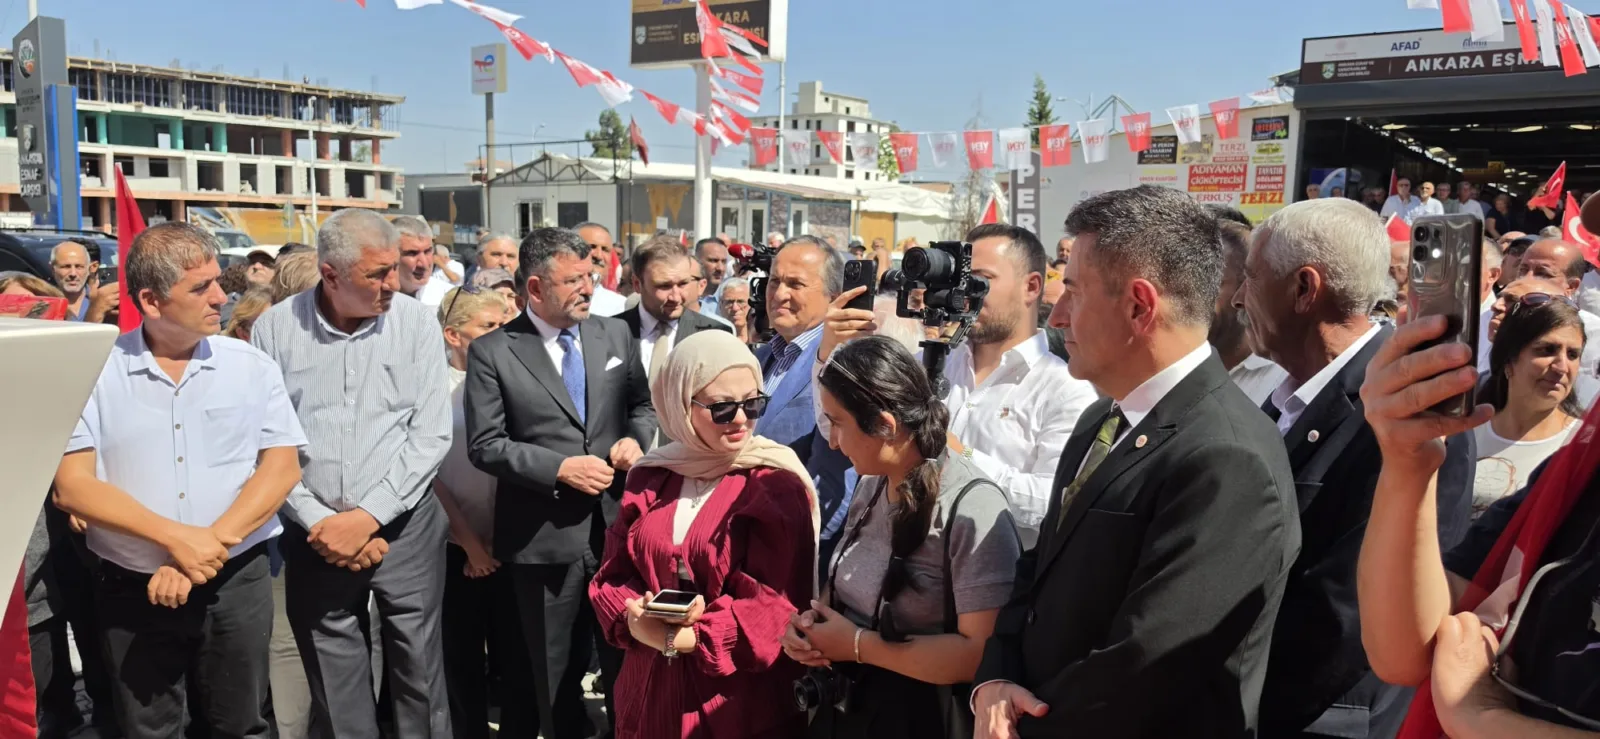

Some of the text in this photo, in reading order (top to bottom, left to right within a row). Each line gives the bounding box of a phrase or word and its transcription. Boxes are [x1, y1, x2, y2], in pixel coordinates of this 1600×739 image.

[1391, 41, 1421, 52] AFAD
[1405, 52, 1544, 73] ANKARA ESN
[1192, 164, 1243, 174] ADIYAMAN
